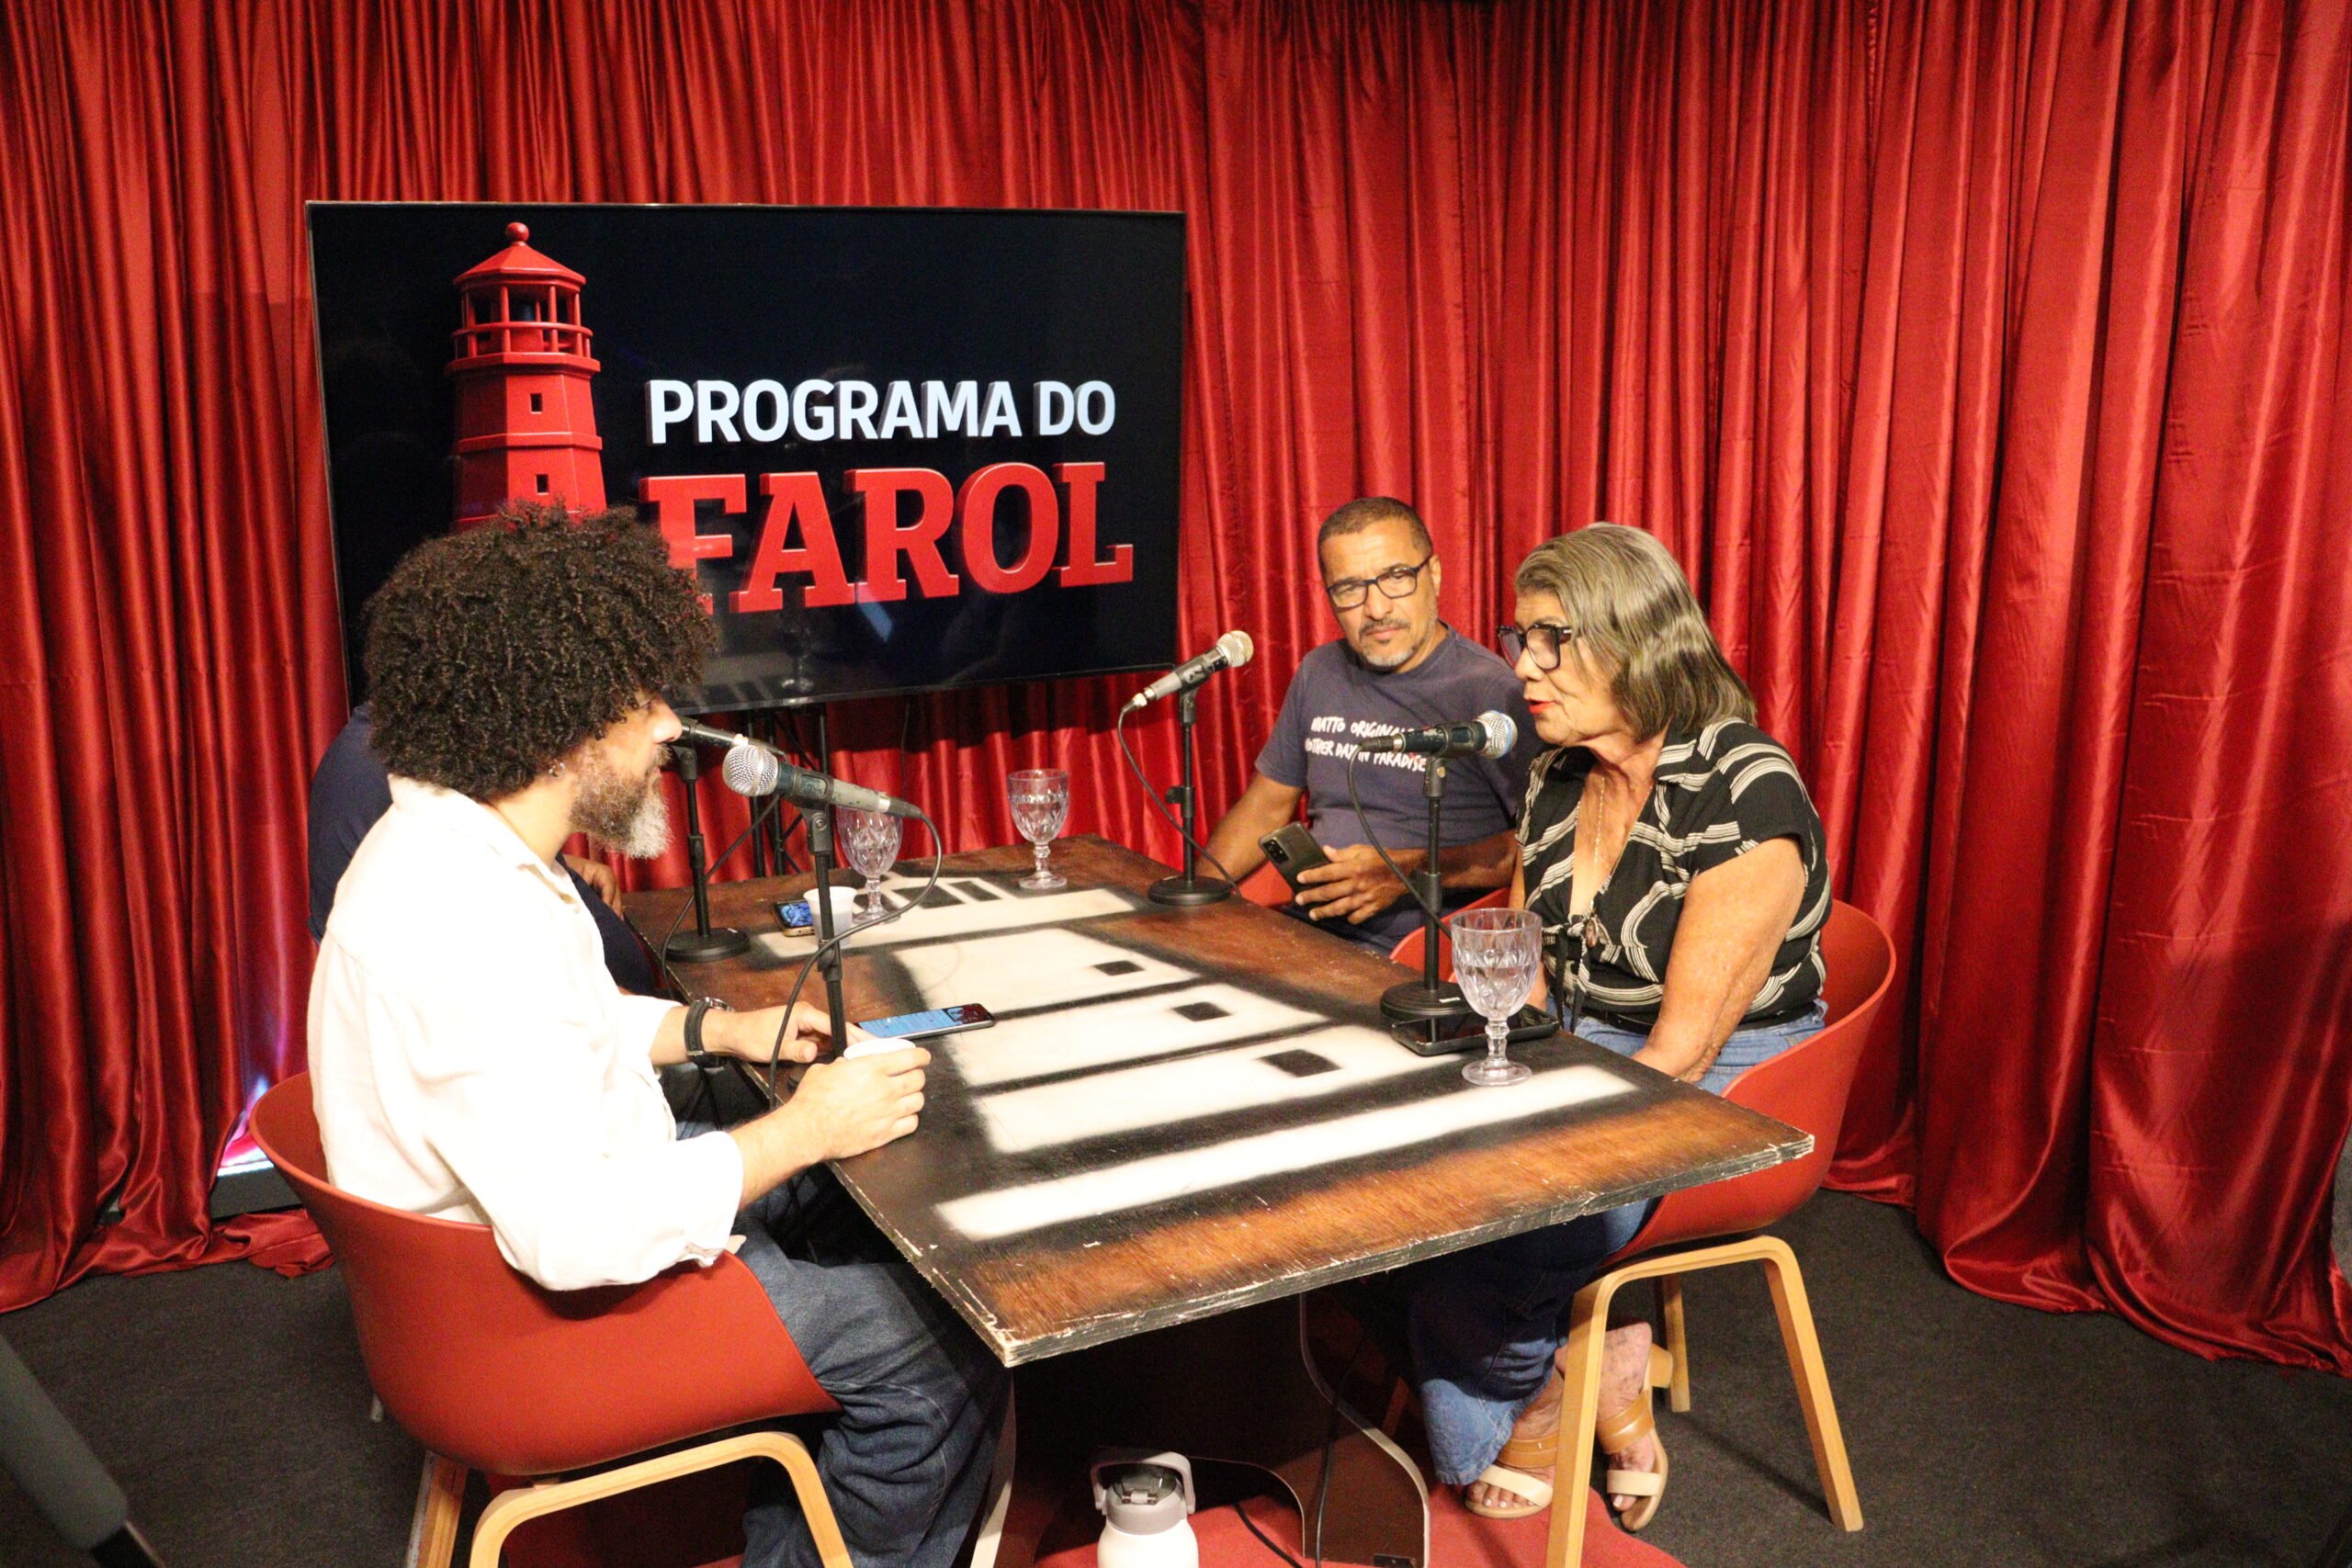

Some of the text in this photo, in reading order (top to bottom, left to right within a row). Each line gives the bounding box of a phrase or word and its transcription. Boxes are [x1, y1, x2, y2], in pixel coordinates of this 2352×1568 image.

[647, 378, 1116, 444] PROGRAMA DO
[639, 461, 1134, 615] FAROL
[1351, 720, 1416, 738] ORIGINA
[1335, 742, 1359, 761] DAY
[1358, 751, 1371, 762] IN
[1373, 750, 1427, 773] PARADISE
